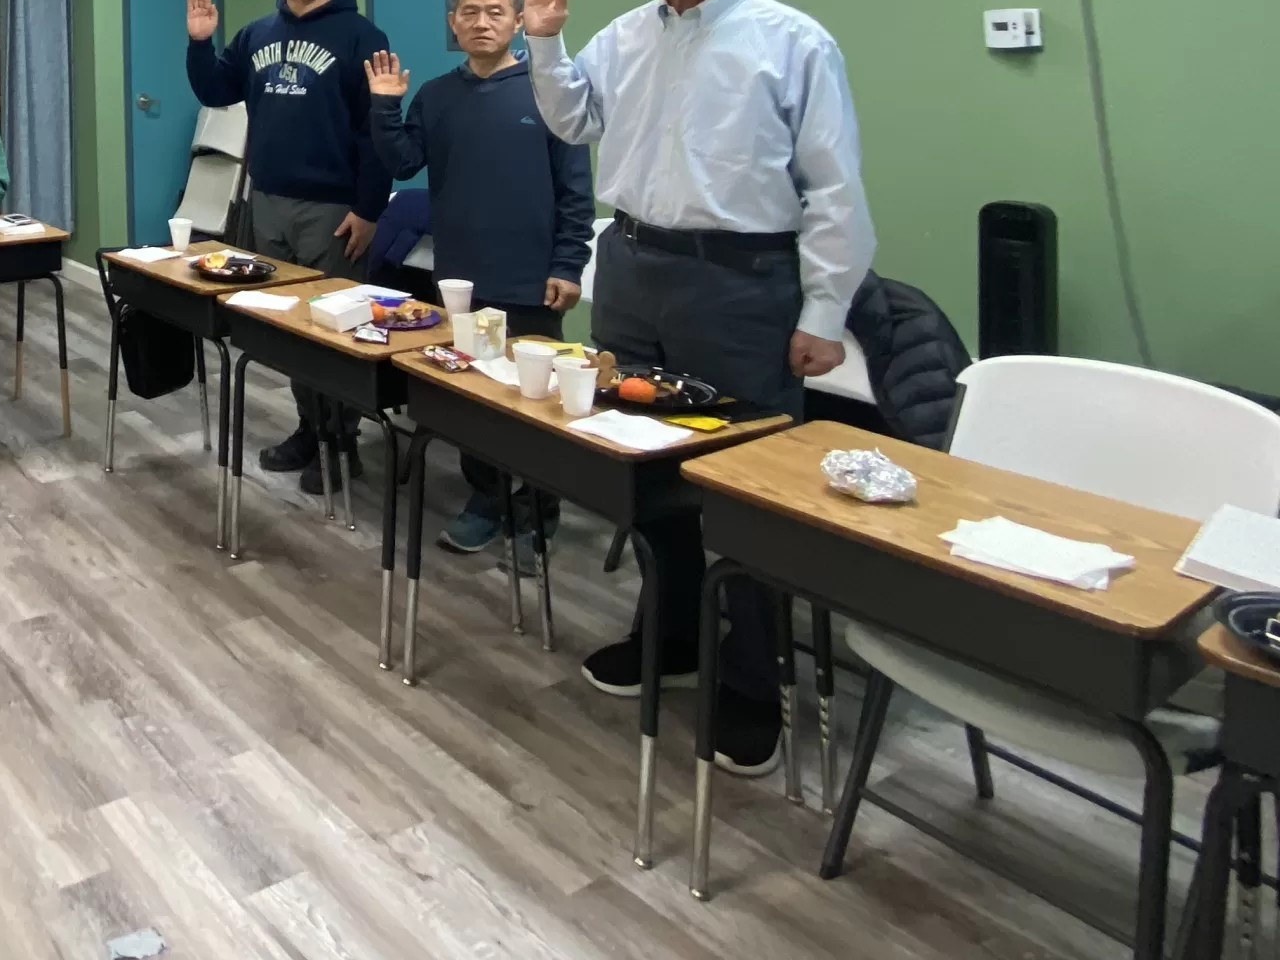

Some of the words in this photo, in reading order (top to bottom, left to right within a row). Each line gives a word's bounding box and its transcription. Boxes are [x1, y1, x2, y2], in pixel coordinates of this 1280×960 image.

[251, 41, 282, 72] NORTH
[286, 39, 336, 75] CAROLINA
[279, 63, 298, 83] USA
